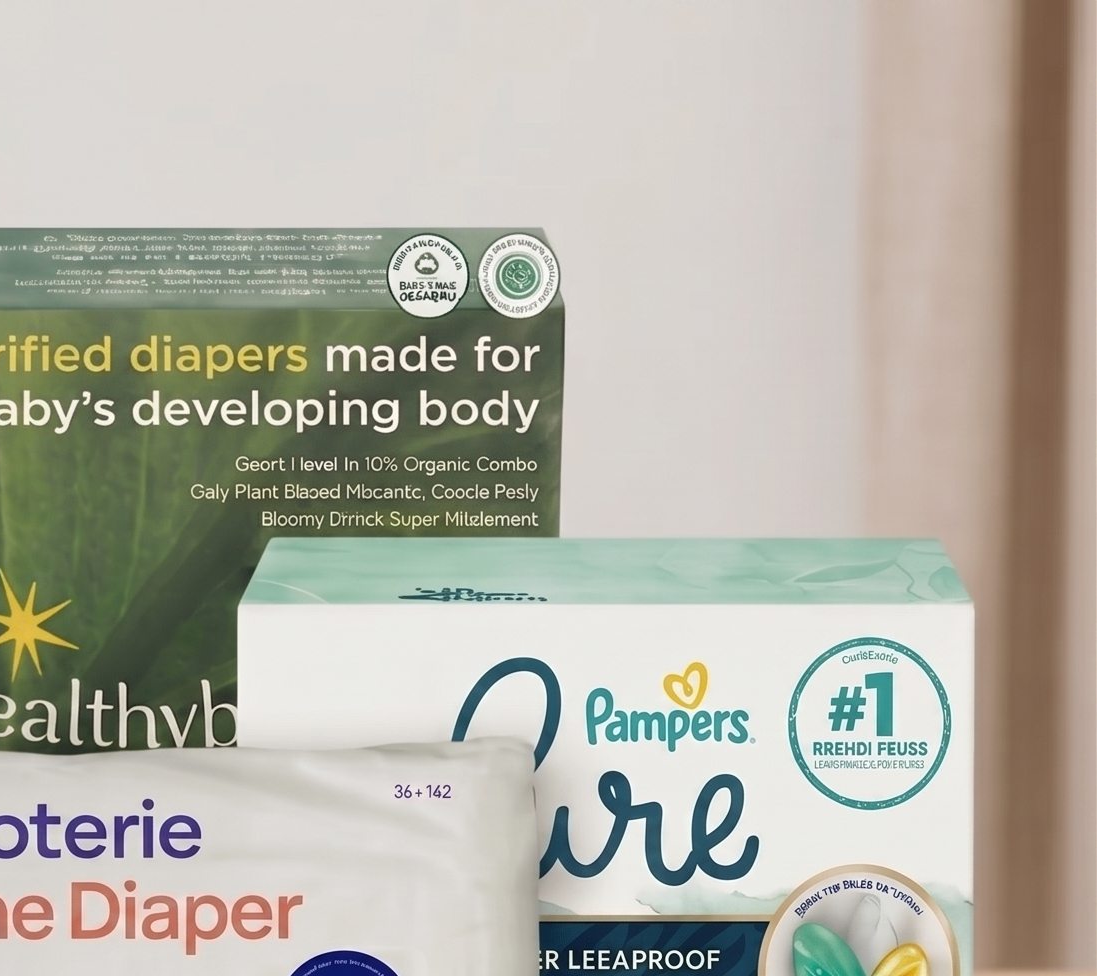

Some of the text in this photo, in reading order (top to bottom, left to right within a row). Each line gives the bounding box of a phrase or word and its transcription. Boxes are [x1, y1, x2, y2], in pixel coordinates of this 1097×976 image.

[129, 335, 309, 380] diapers
[325, 335, 458, 373] made
[474, 335, 541, 373] for
[132, 390, 401, 434] developing
[418, 390, 540, 434] body
[235, 456, 286, 472] Geort
[300, 456, 338, 472] level
[344, 457, 359, 472] In
[365, 456, 398, 472] 10%
[403, 456, 471, 477] Organic
[476, 456, 538, 472] Combo
[190, 484, 230, 503] Galy
[235, 484, 279, 500] Plant
[431, 484, 490, 500] Coocle
[494, 484, 540, 503] Pesly
[261, 511, 325, 530] Bloomy
[390, 511, 440, 530] Super
[828, 671, 894, 737] #1
[585, 687, 751, 753] Pampers
[877, 741, 929, 756] FEUSS
[394, 784, 413, 799] 36
[70, 879, 304, 956] Diaper
[568, 949, 721, 970] LEEAPROOF
